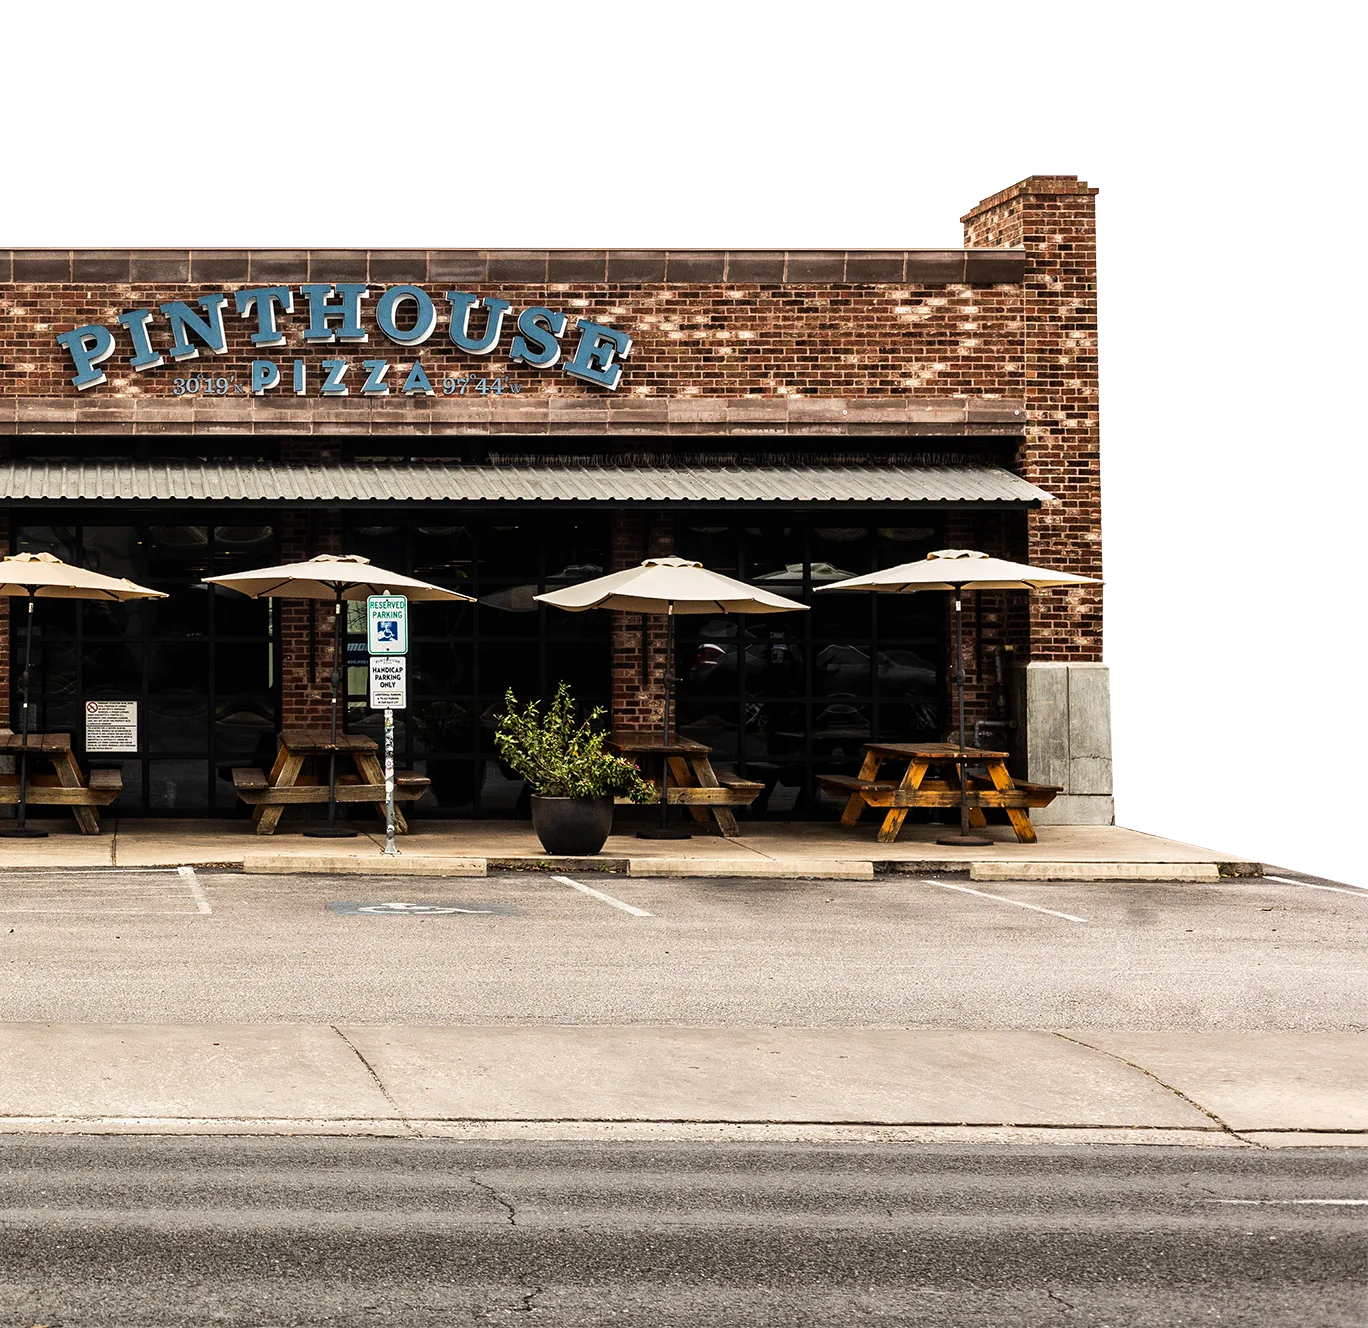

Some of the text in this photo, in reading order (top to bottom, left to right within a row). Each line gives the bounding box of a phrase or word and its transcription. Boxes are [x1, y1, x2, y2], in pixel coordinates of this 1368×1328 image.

[56, 283, 633, 391] PINTHOUSE
[252, 360, 435, 396] PIZZA
[370, 601, 405, 609] RESERVED
[372, 611, 403, 619] PARKING
